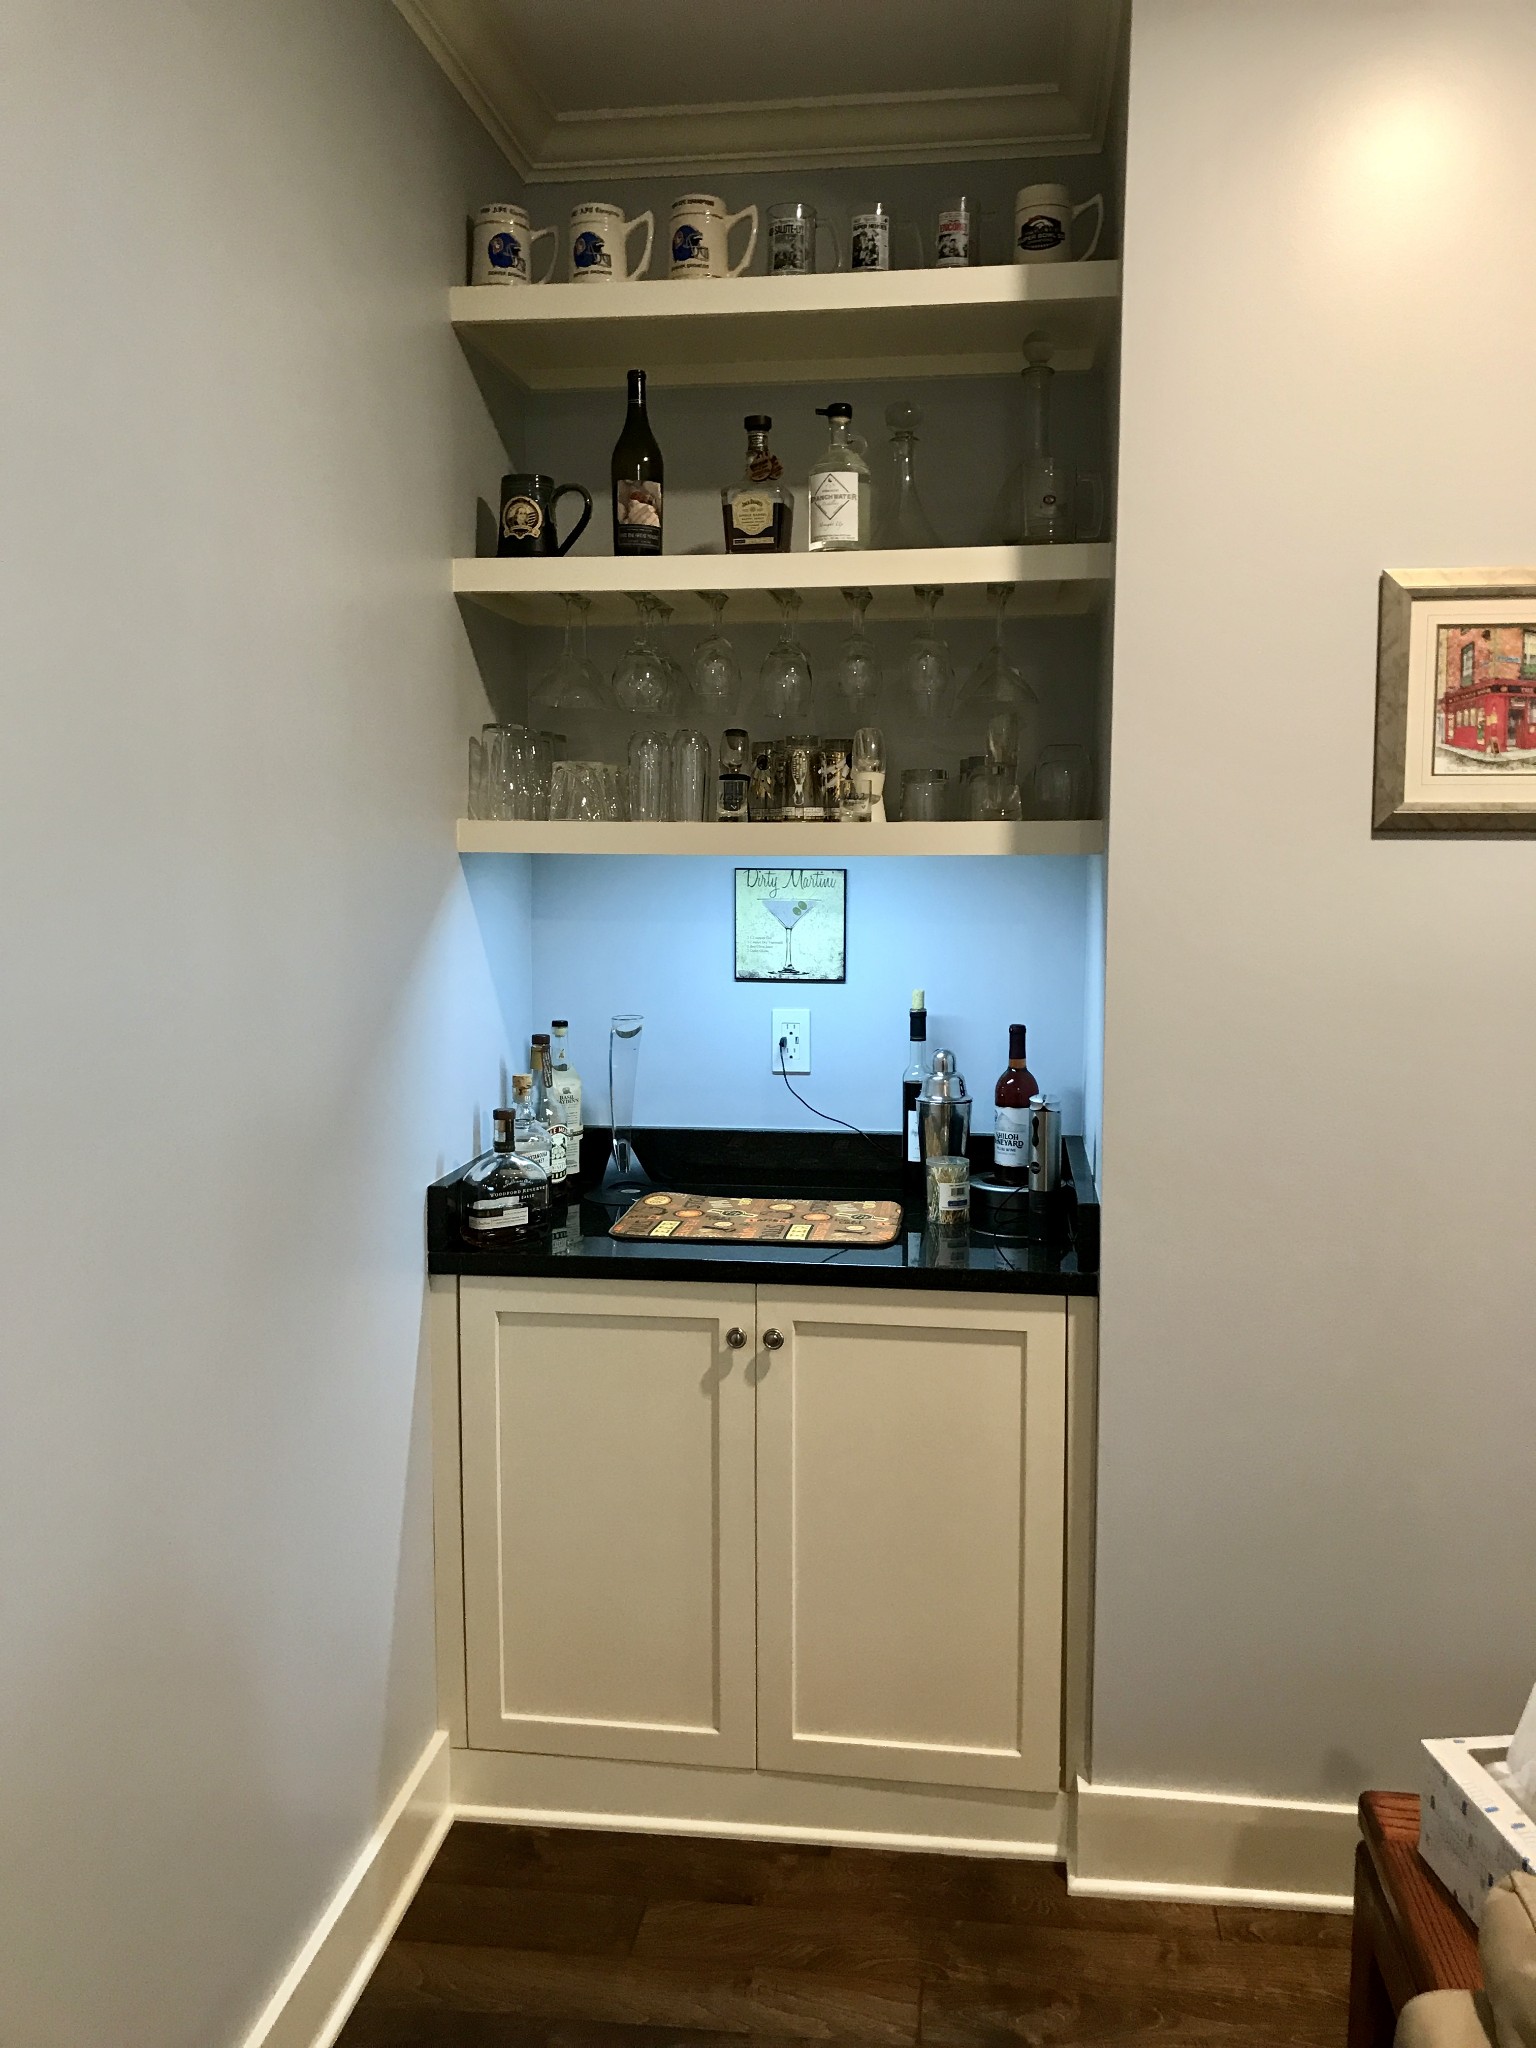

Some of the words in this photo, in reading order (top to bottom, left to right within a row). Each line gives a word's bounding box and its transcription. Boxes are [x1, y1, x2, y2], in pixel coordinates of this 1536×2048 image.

[742, 869, 780, 898] Dirty
[782, 869, 836, 889] Martini
[996, 1139, 1024, 1149] NEYARD
[489, 1188, 521, 1198] WOODFORD
[522, 1185, 546, 1194] RESERVE
